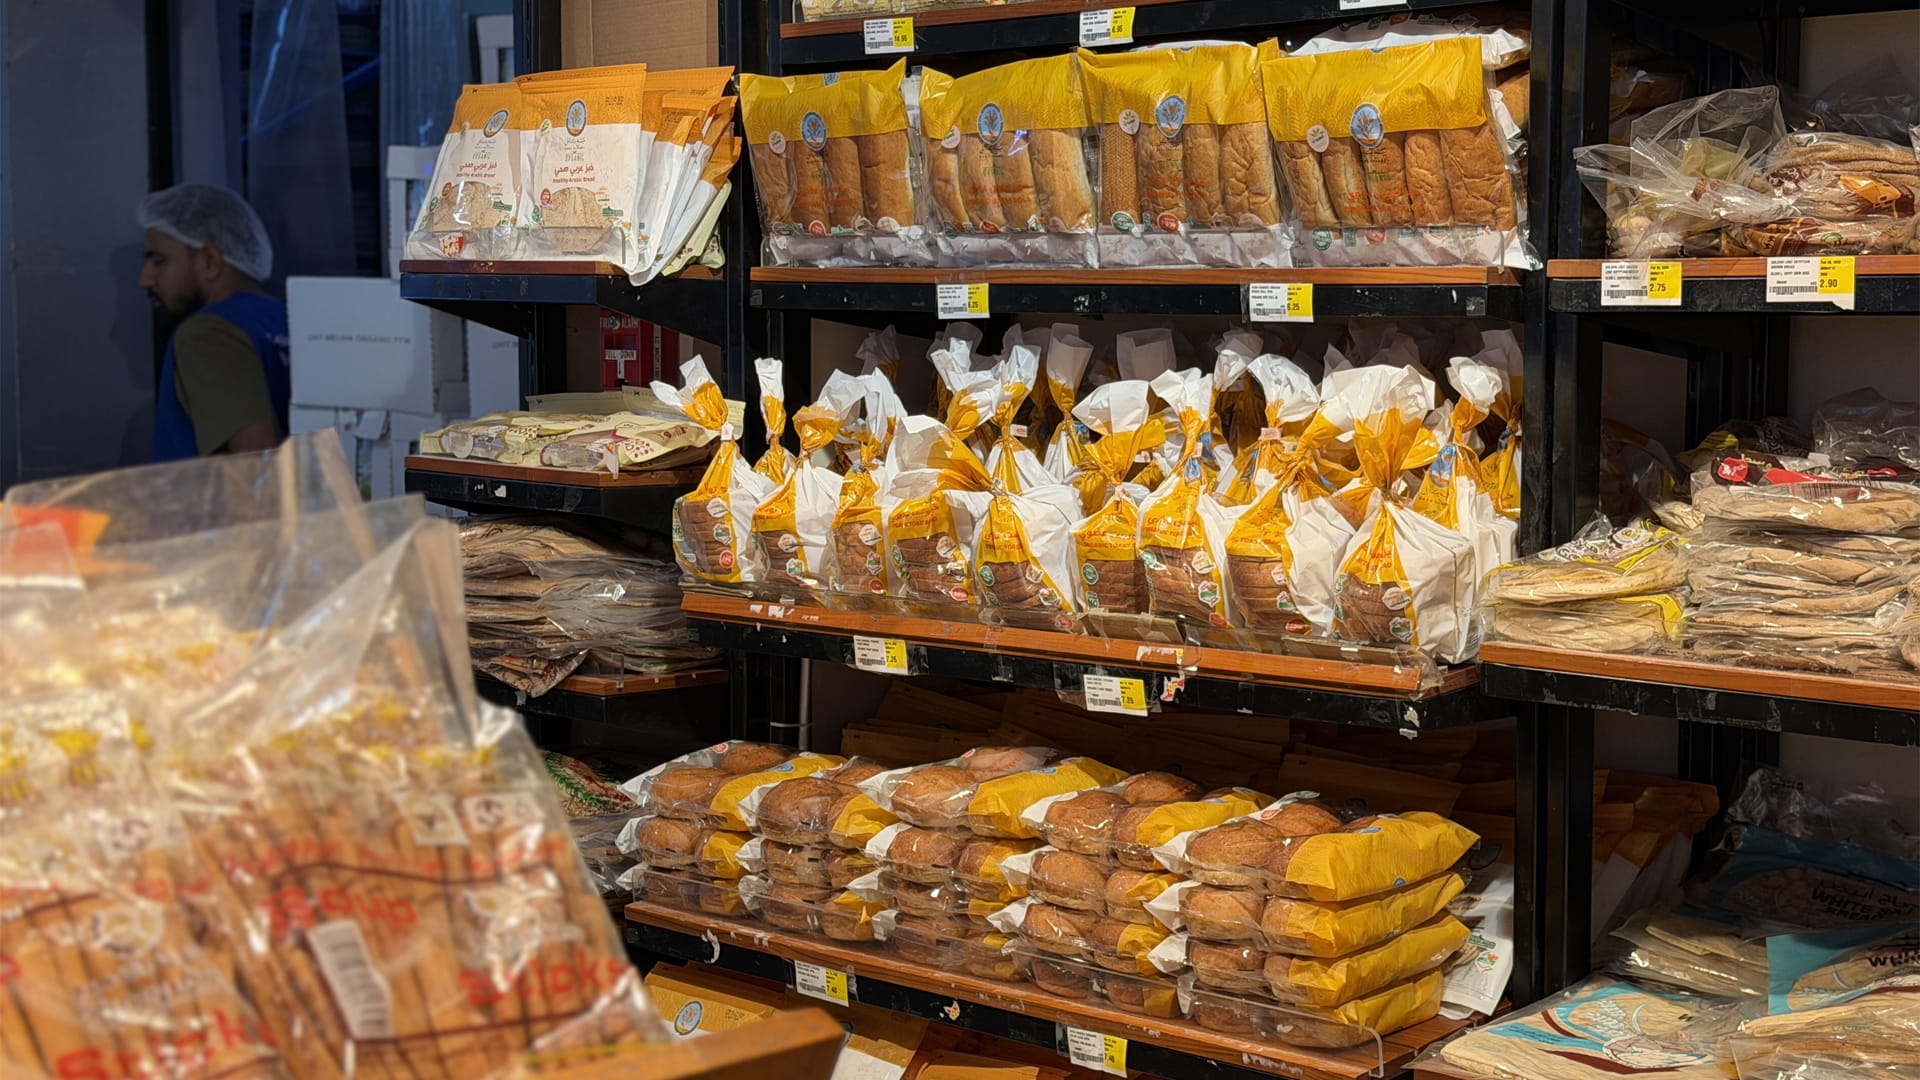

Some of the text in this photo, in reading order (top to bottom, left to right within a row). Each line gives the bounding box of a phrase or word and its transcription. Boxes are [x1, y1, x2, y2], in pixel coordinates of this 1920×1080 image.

[1649, 283, 1666, 292] 2.75
[1820, 279, 1838, 288] 2.90
[1121, 696, 1134, 705] 7.25
[1812, 888, 1872, 914] WHITE
